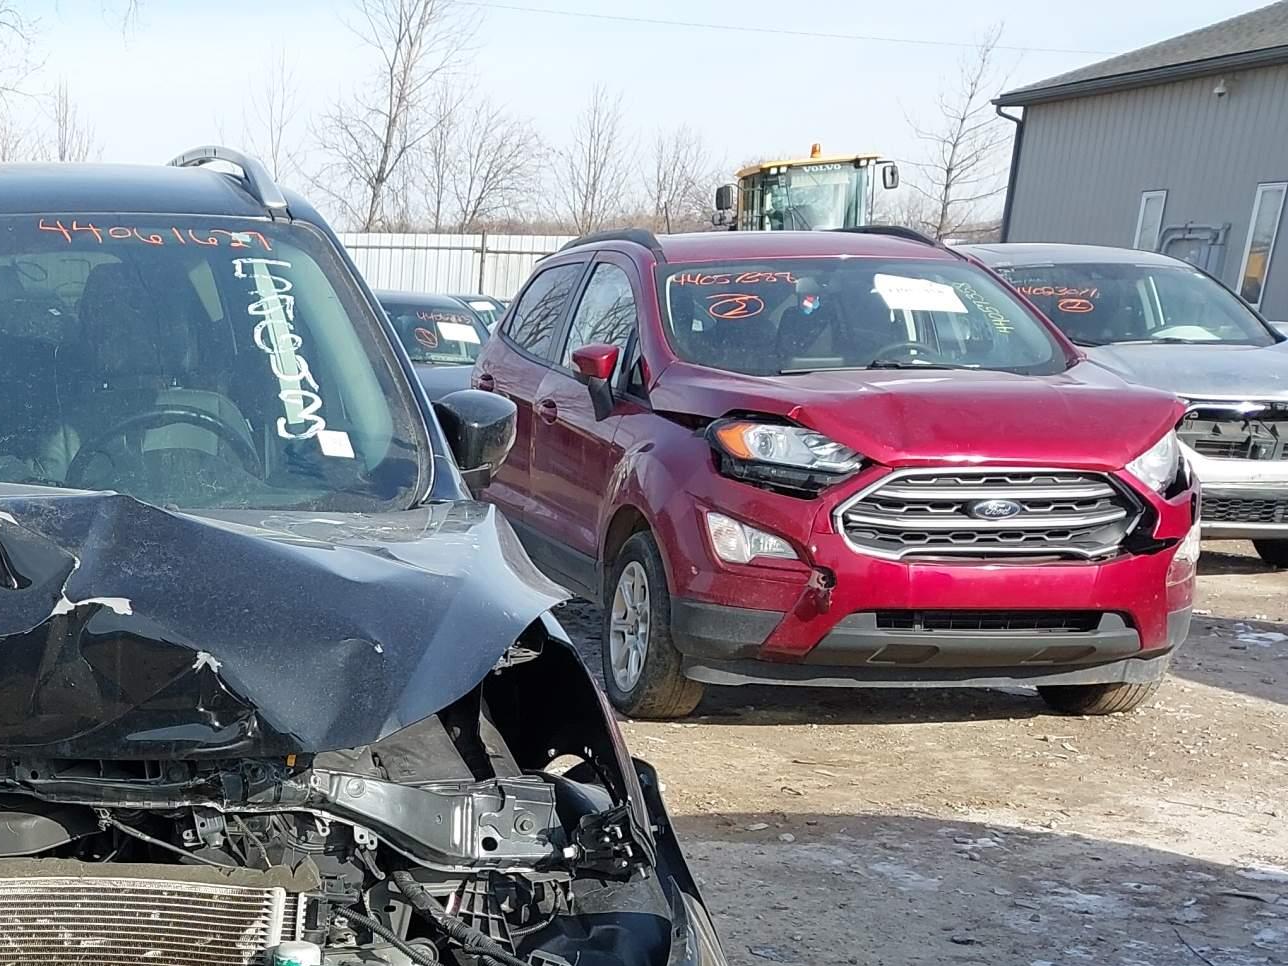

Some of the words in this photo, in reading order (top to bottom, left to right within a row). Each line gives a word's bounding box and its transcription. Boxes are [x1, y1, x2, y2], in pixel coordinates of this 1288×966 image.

[802, 163, 842, 173] VOLVO
[38, 218, 273, 252] 44061627
[984, 502, 1012, 516] Ford
